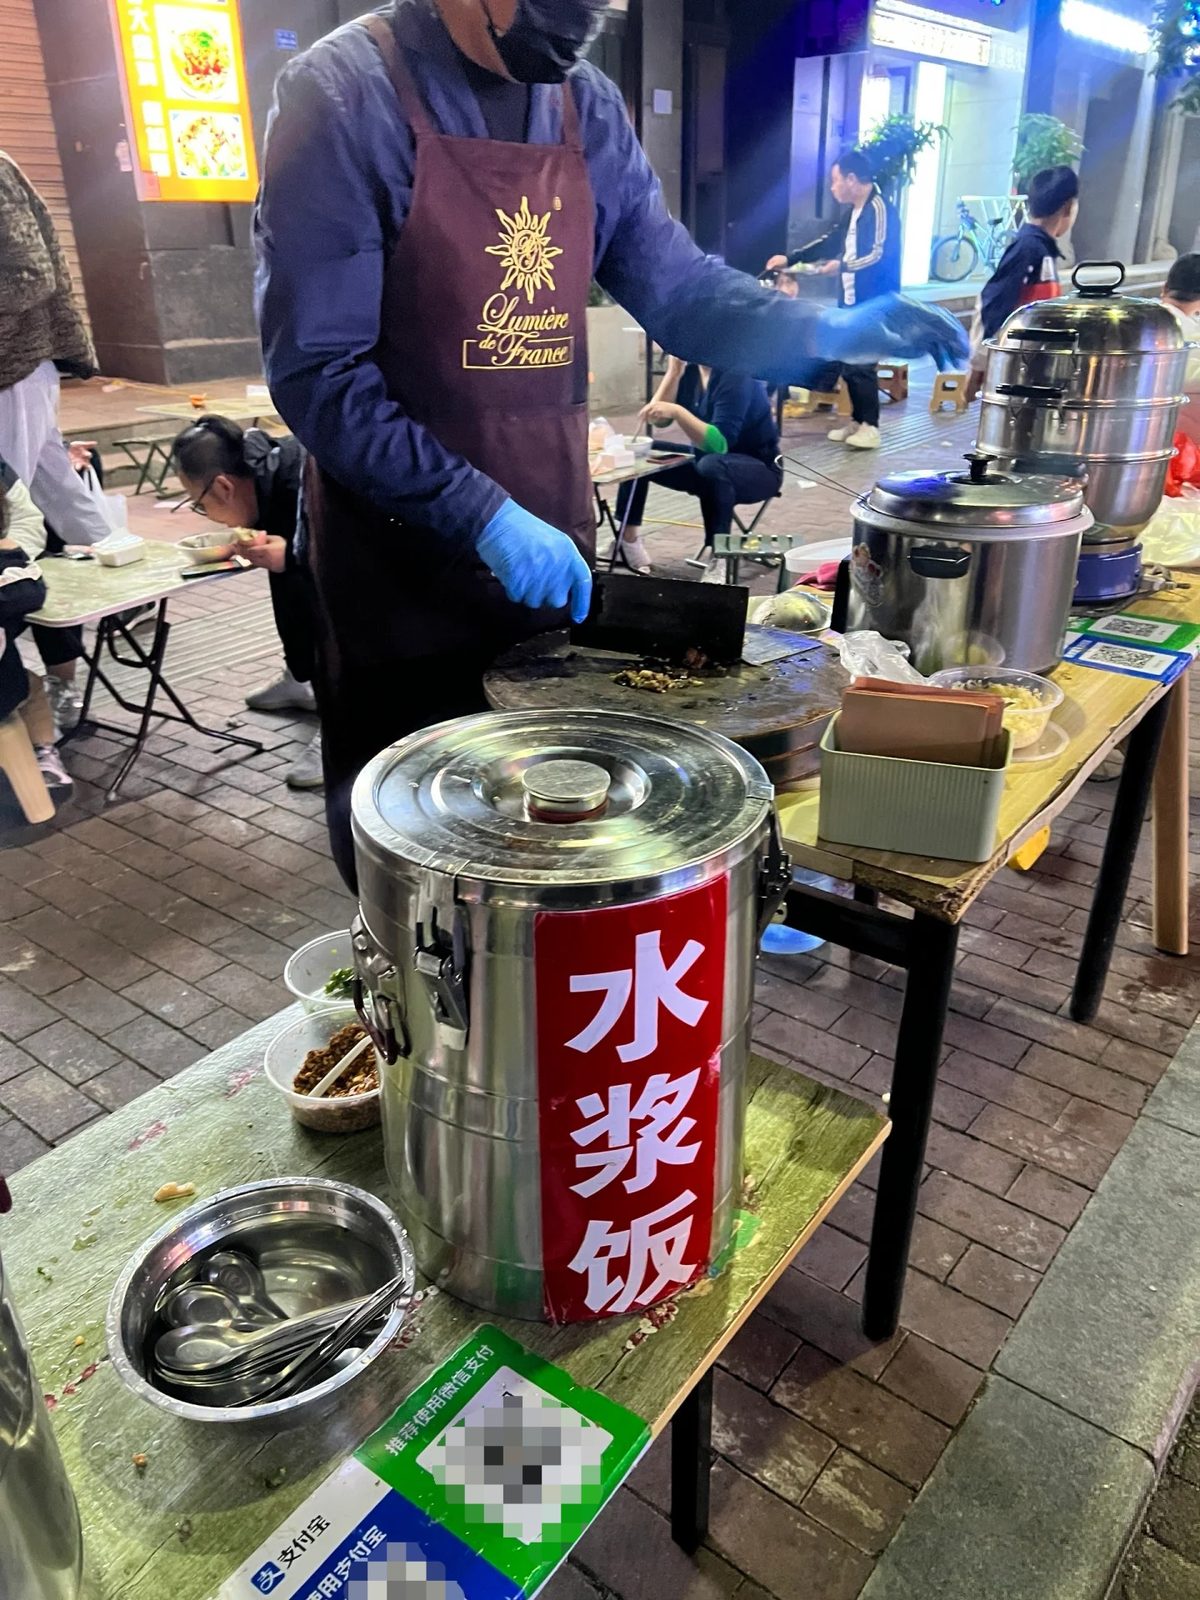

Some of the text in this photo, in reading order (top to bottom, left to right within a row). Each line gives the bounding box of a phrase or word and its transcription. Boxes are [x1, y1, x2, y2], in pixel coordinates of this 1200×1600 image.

[477, 293, 569, 333] Lumière
[479, 331, 569, 366] de France
[564, 929, 710, 1313] 水浆饭
[384, 1344, 494, 1456] 推荐使用微信支付
[277, 1515, 331, 1569] 支付宝
